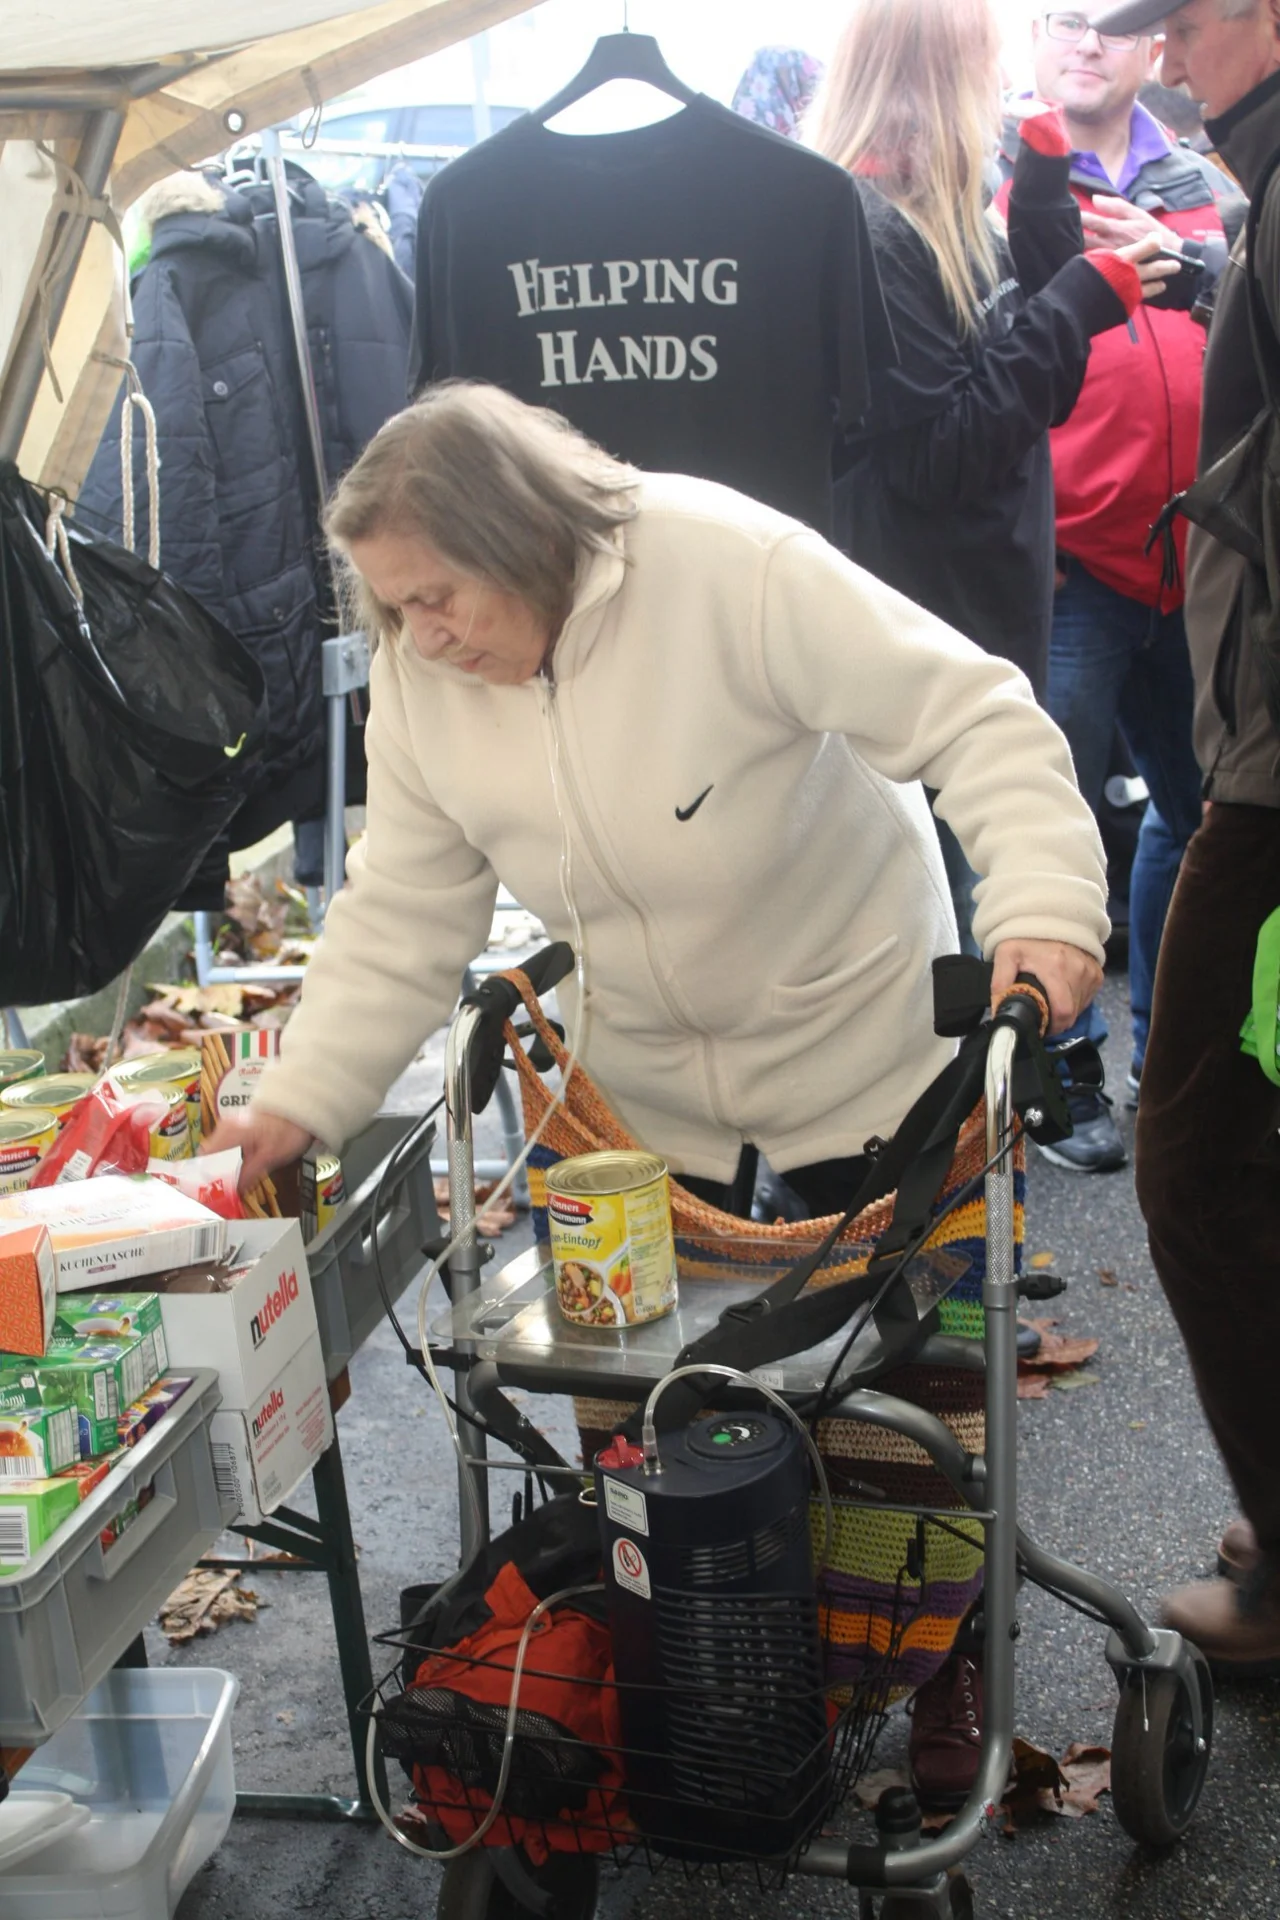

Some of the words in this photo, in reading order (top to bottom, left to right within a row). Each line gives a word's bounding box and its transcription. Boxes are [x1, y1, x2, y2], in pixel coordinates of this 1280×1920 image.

[507, 258, 738, 317] HELPING
[537, 330, 718, 387] HANDS
[250, 1266, 299, 1347] nutella
[252, 1387, 284, 1438] nutella
